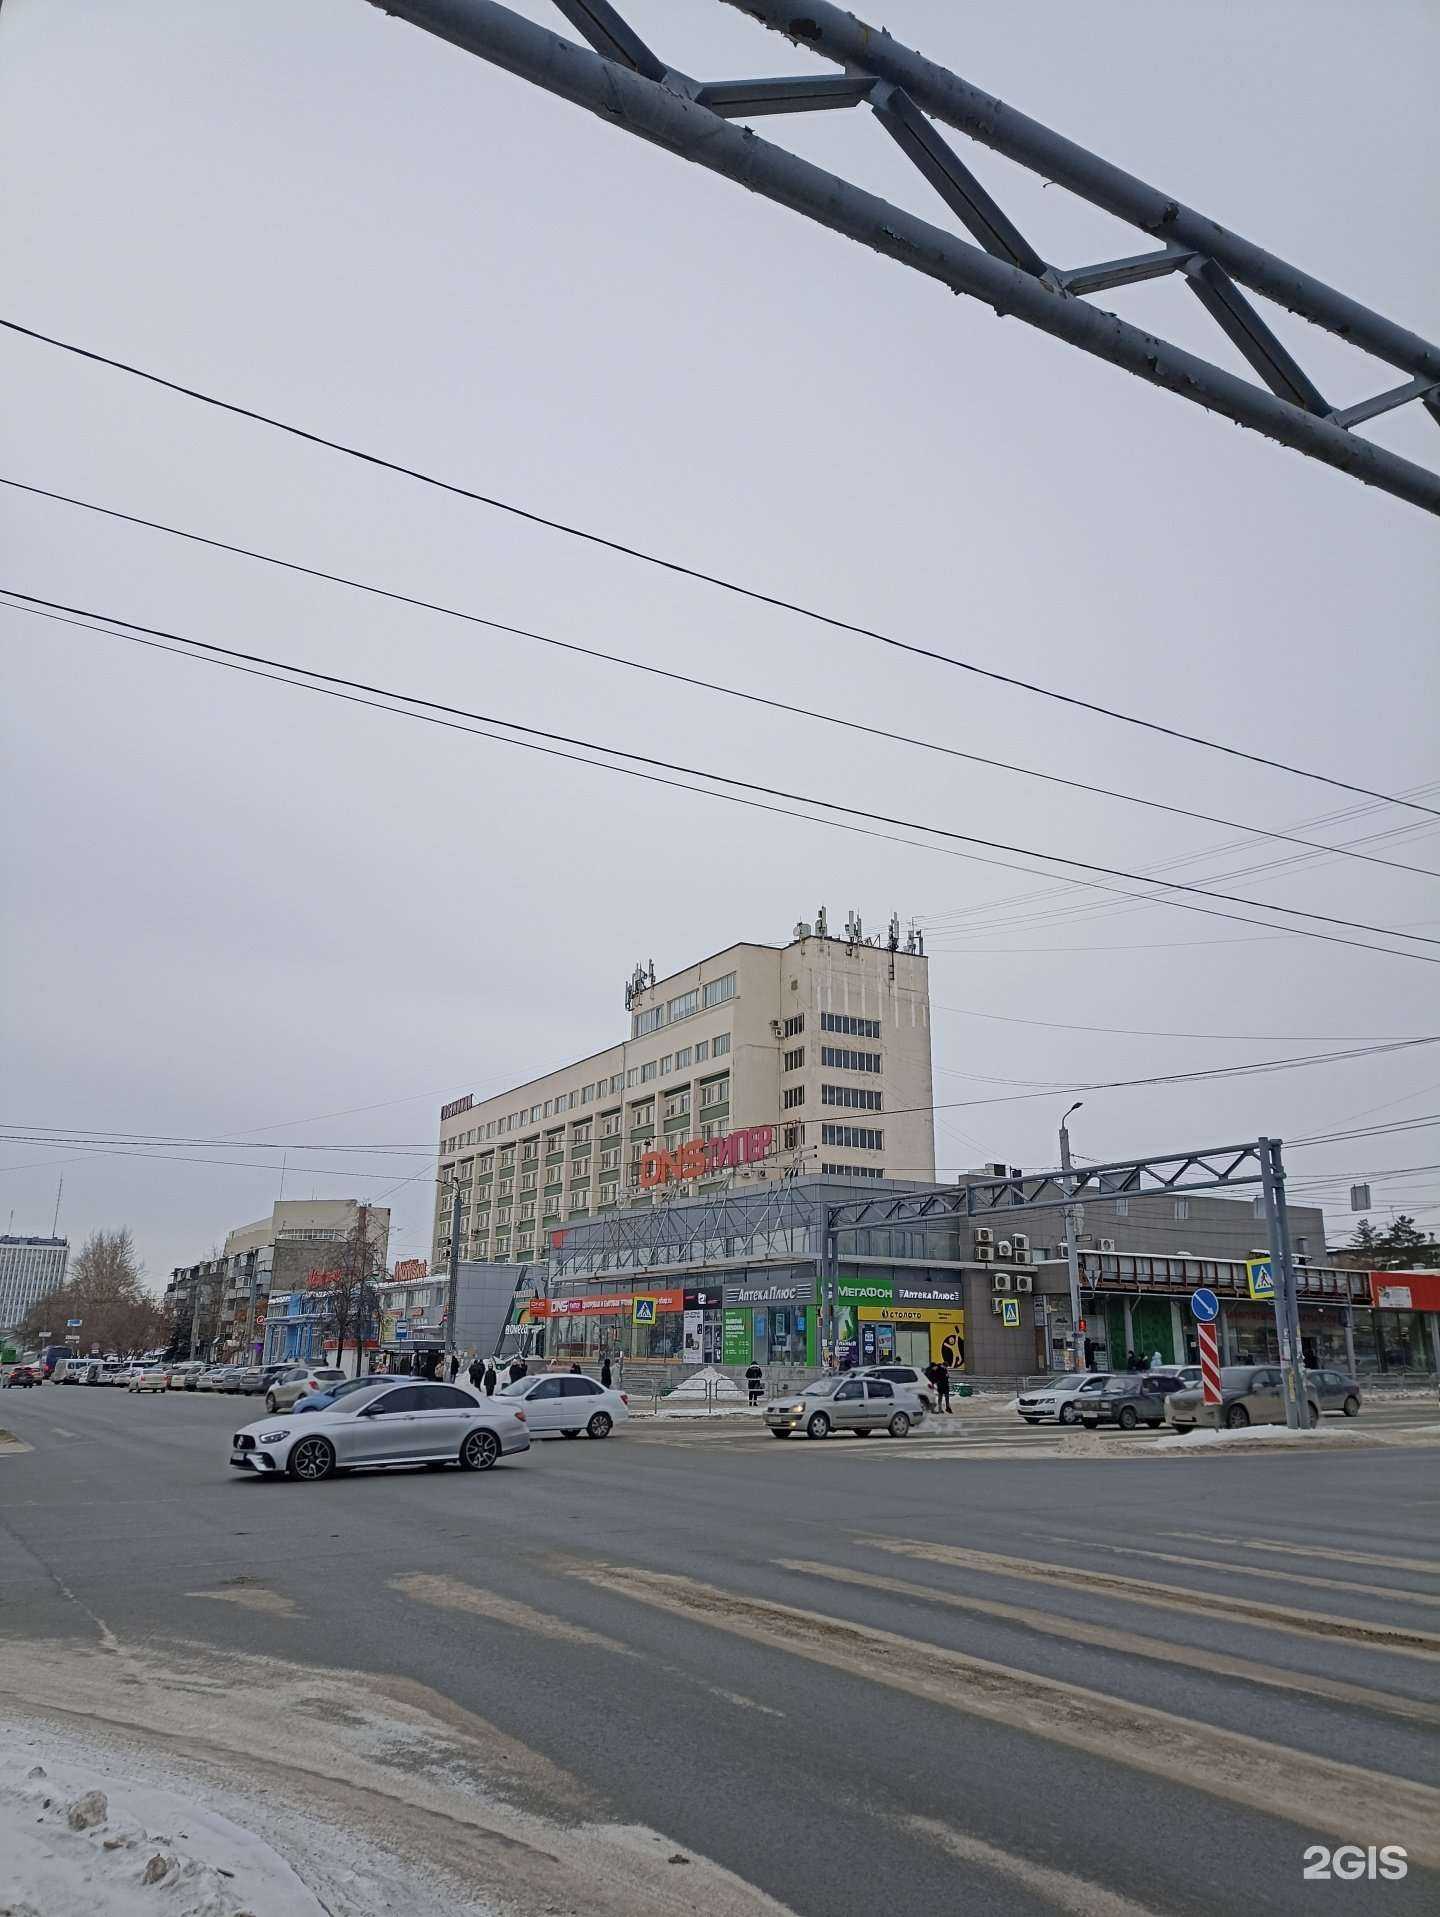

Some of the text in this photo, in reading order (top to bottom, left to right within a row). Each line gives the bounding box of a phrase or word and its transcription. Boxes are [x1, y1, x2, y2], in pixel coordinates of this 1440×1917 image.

[639, 1125, 772, 1188] DNS ГИПЕР
[551, 1301, 568, 1312] DNS
